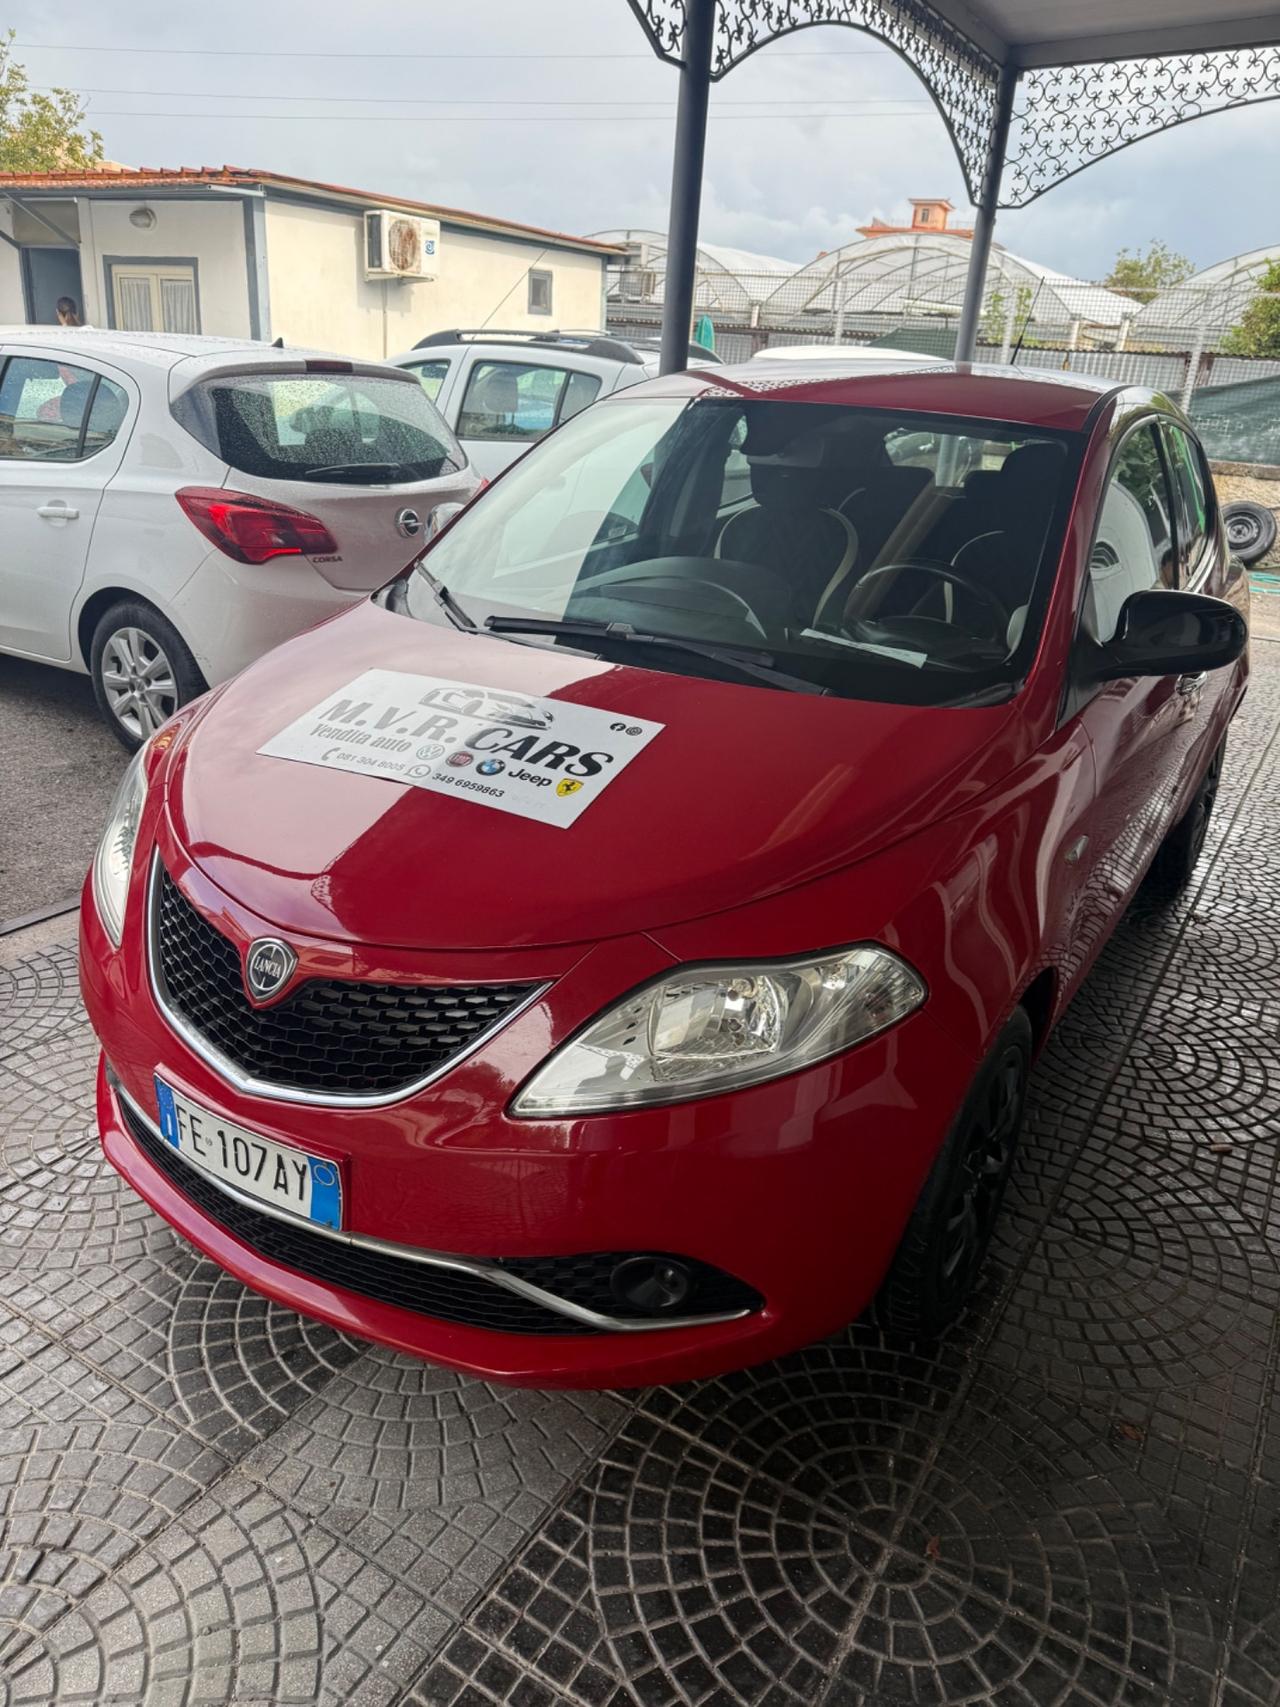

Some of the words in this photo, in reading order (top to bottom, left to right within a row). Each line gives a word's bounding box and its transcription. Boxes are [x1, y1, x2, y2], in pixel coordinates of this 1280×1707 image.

[309, 723, 372, 745] Vendita
[369, 736, 412, 752] auto
[318, 699, 456, 743] M.V.R.
[465, 727, 614, 776] CARS
[336, 752, 357, 761] 081
[432, 773, 453, 784] 349
[454, 778, 505, 798] 6959863
[508, 768, 552, 787] Jeep
[254, 956, 281, 977] LANCIA
